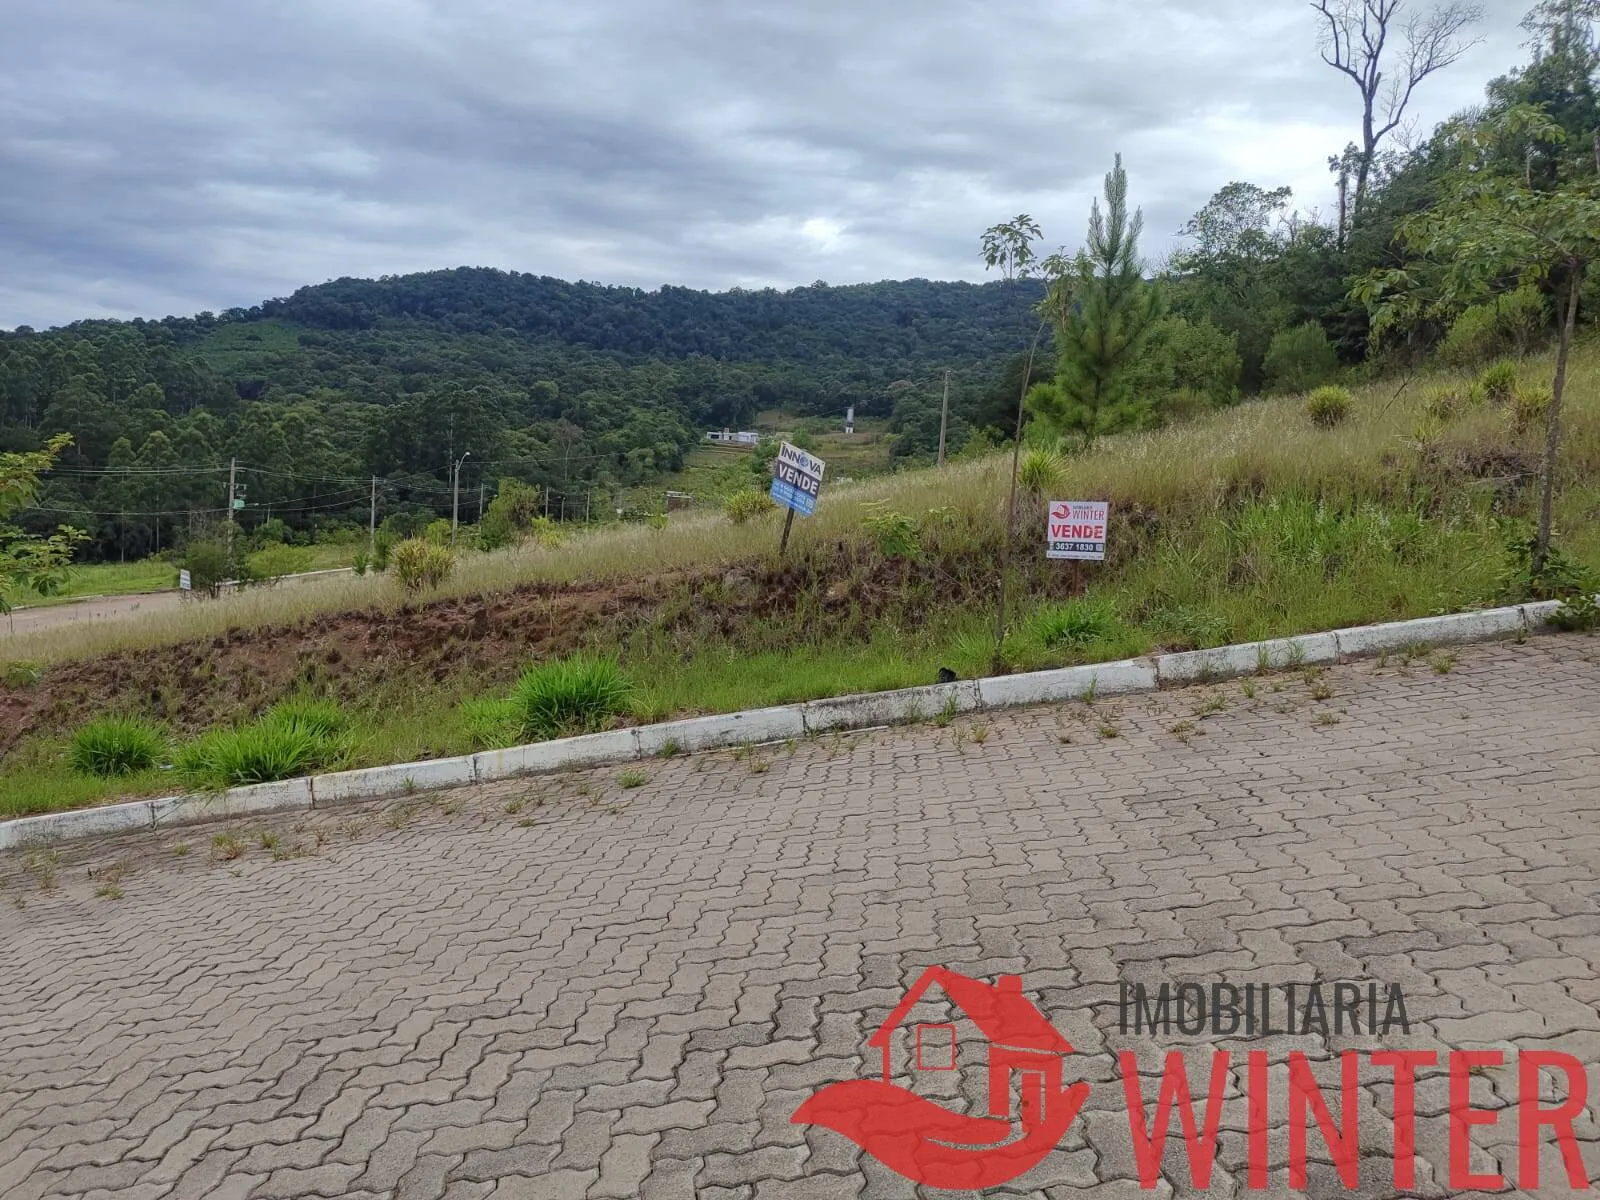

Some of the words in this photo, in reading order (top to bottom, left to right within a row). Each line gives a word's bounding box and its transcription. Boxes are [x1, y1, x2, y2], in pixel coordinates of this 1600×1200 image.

[781, 445, 822, 476] INNOVA
[779, 463, 819, 495] VENDE
[1072, 510, 1105, 521] WINTER
[1051, 524, 1104, 539] VENDE
[1055, 542, 1074, 551] 3637
[1076, 543, 1094, 551] 1830
